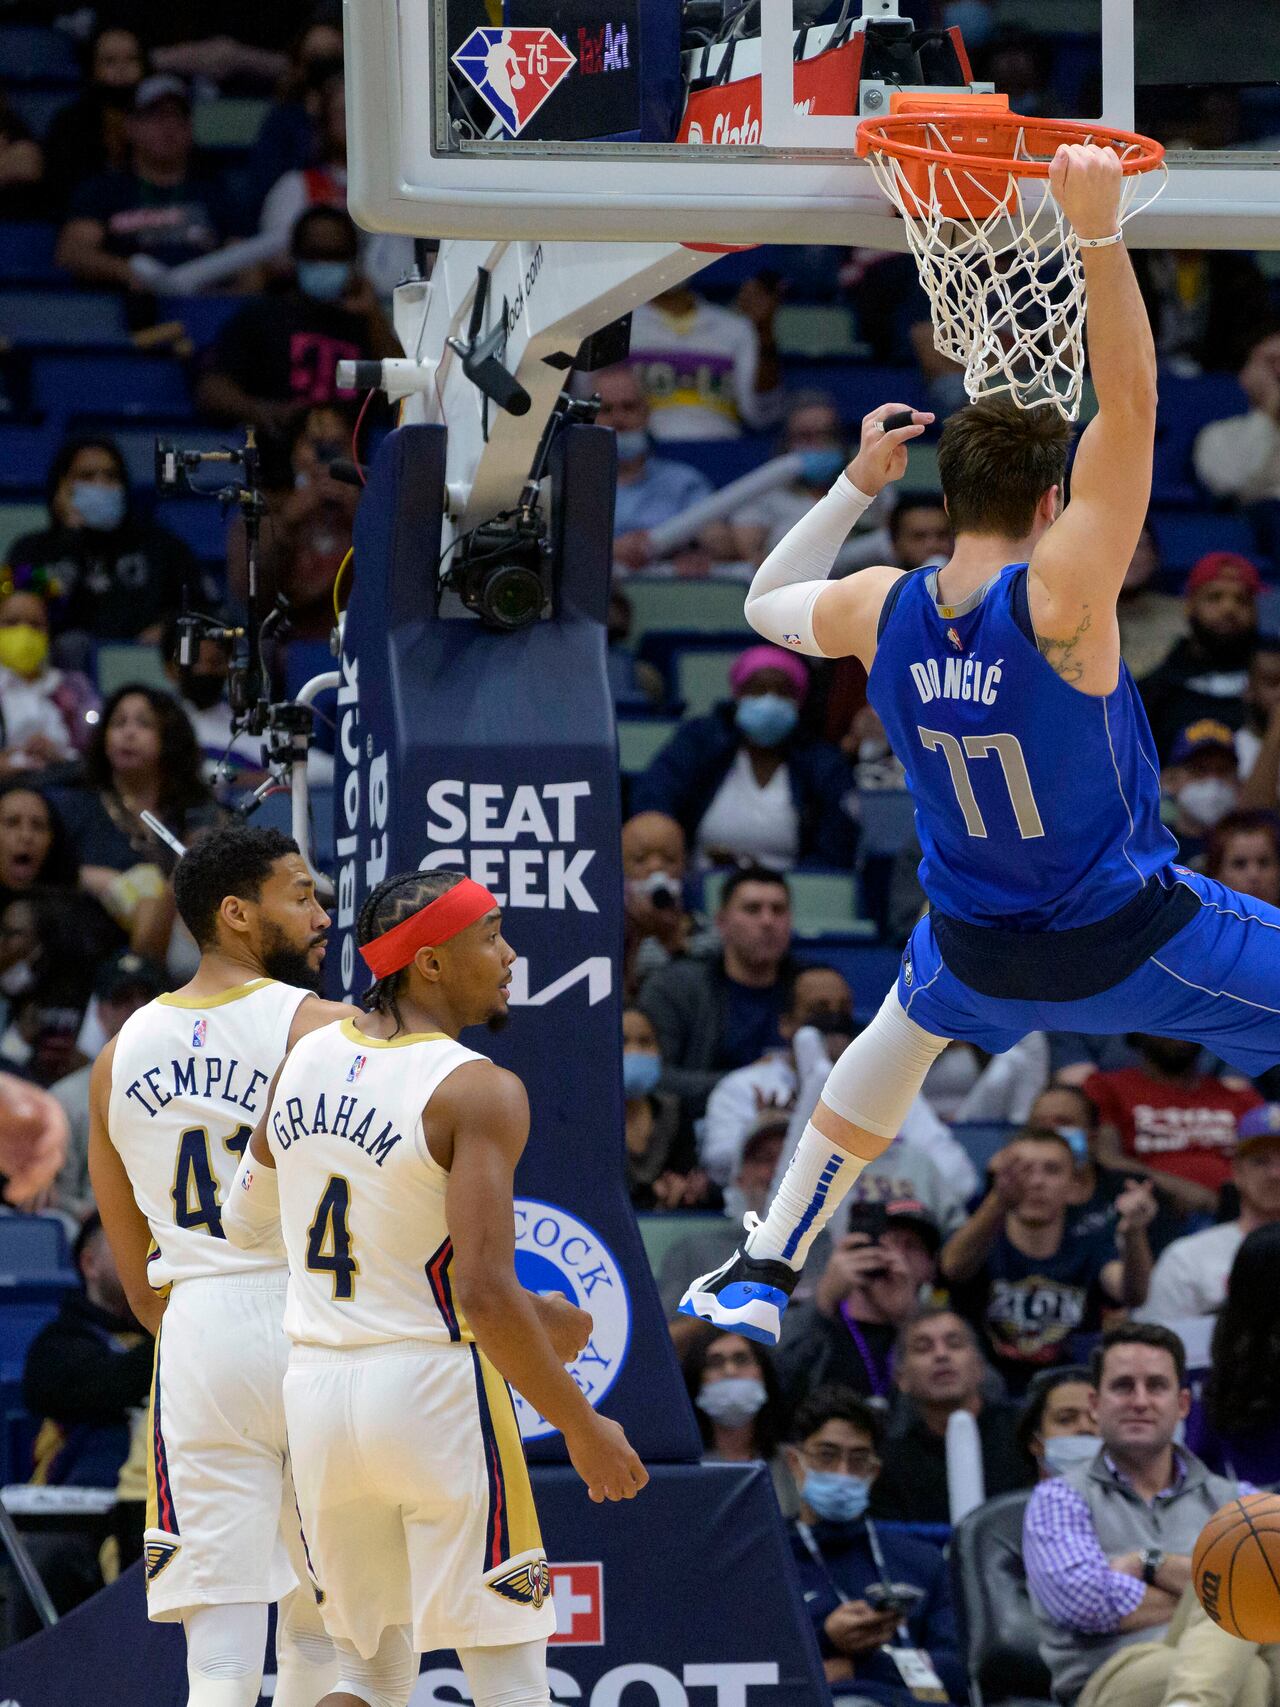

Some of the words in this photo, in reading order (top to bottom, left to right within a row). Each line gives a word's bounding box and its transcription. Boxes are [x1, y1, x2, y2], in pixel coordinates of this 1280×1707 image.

[525, 44, 548, 75] 75
[909, 651, 1004, 706] DONČIĆ
[426, 779, 591, 843] SEAT
[916, 725, 1046, 840] 77
[126, 1056, 268, 1117] TEMPLE
[273, 1093, 402, 1167] GRAHAM
[305, 1172, 361, 1303] 4
